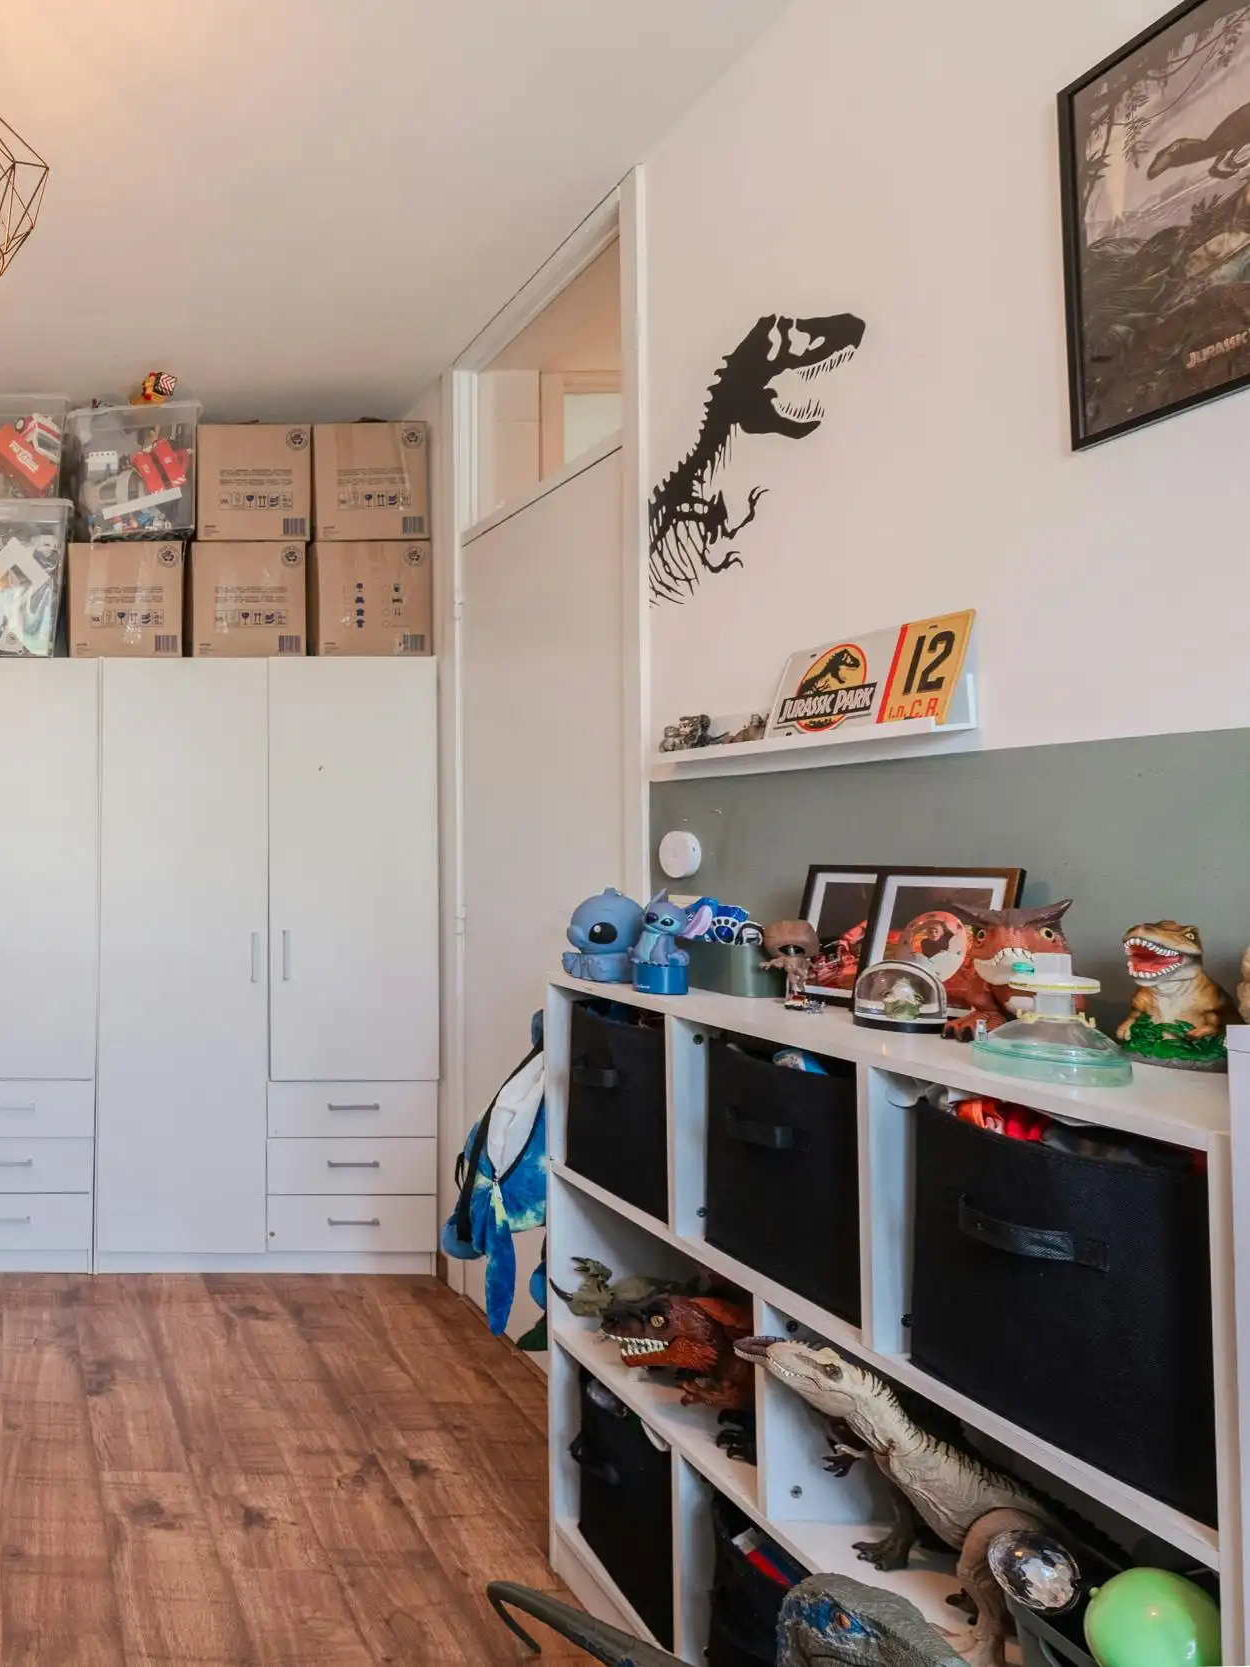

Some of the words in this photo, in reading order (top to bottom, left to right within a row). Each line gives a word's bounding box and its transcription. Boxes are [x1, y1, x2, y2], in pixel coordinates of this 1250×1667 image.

[902, 630, 955, 696] 12
[778, 694, 836, 722] JURASSIC
[832, 687, 875, 715] PARK
